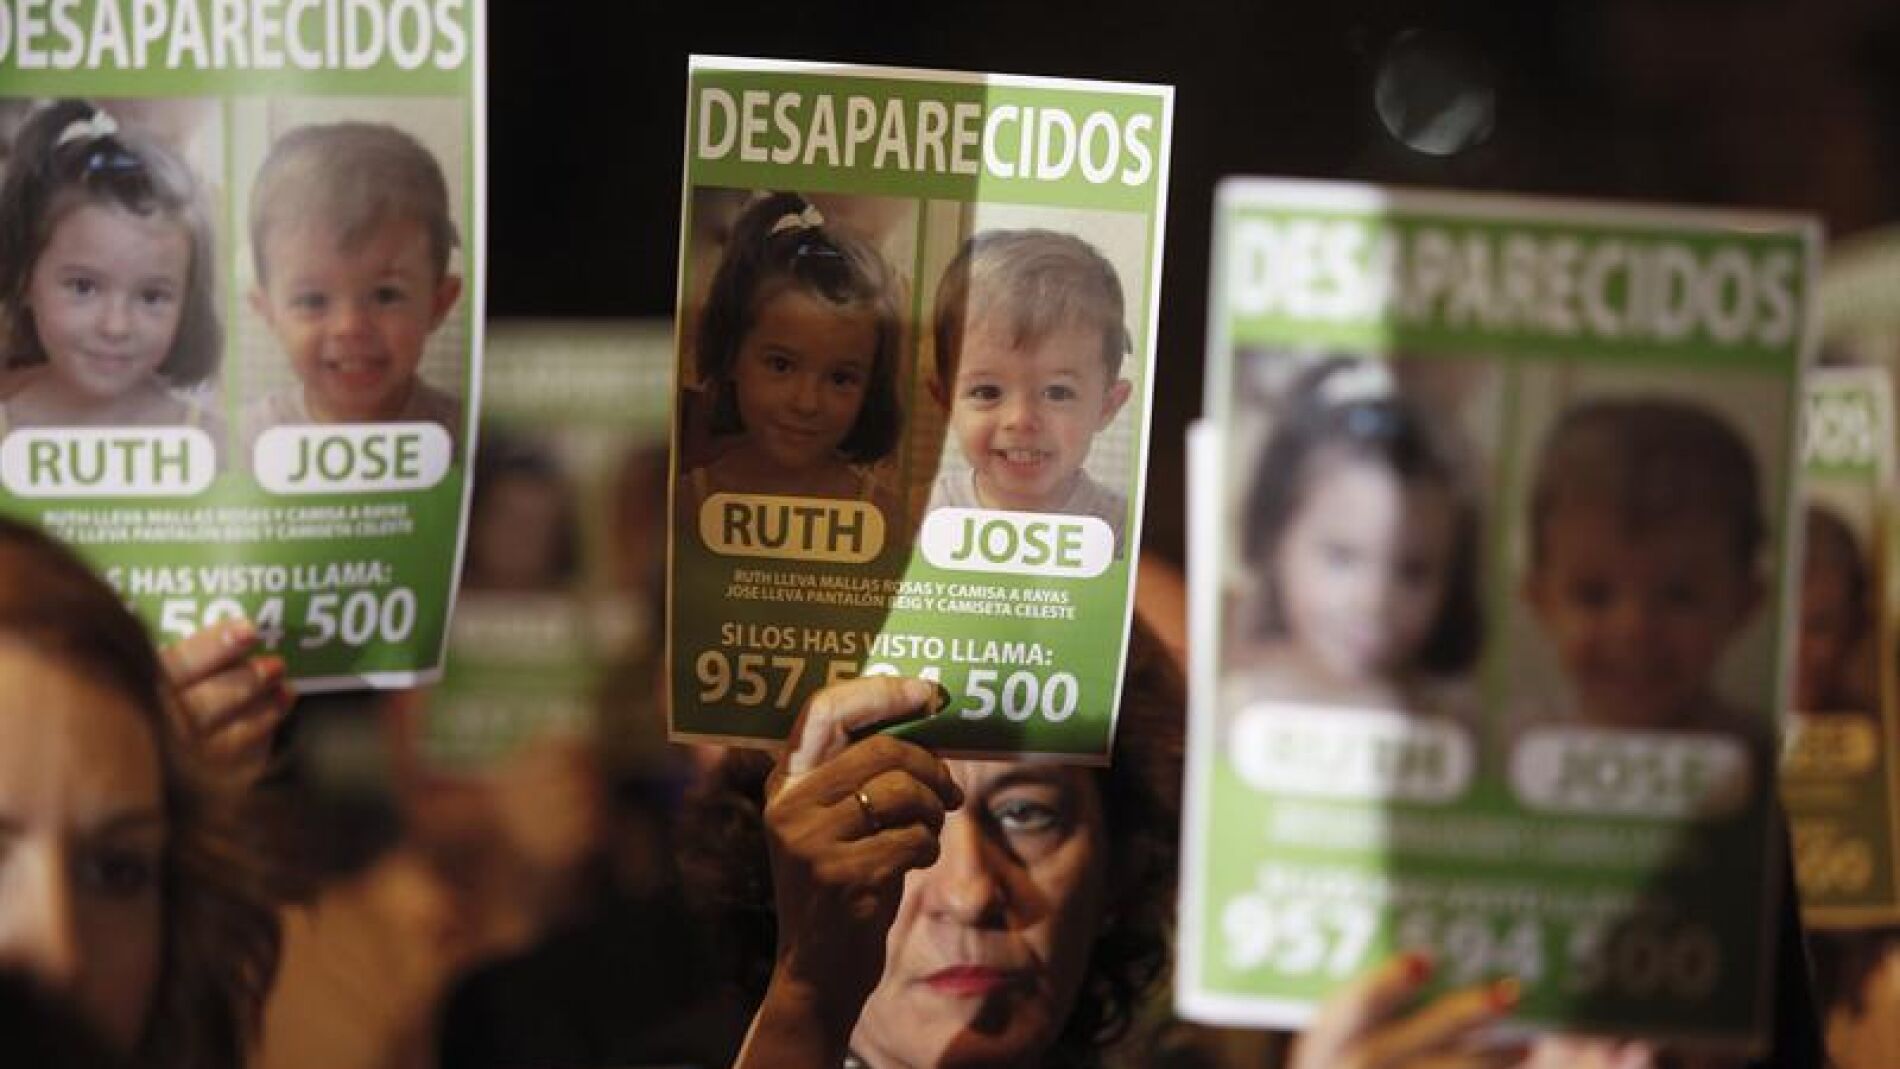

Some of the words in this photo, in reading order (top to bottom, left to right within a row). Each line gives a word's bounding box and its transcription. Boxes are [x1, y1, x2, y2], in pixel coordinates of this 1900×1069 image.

[698, 87, 1153, 186] DESAPARECIDOS
[1233, 214, 1797, 347] DESAPARECIDOS
[28, 438, 190, 485] RUTH
[287, 434, 420, 482] JOSE
[723, 503, 864, 553] RUTH
[950, 517, 1084, 568] JOSE
[131, 565, 194, 594] HAS
[199, 565, 289, 594] VISTO
[293, 560, 393, 591] LLAMA:
[724, 584, 760, 600] JOSE
[762, 586, 803, 602] LLEVA
[924, 597, 934, 610] Y
[937, 598, 1012, 615] CAMISETA
[1015, 602, 1076, 620] CELESTE
[734, 569, 772, 584] RUTH
[774, 572, 816, 588] LLEVA
[820, 575, 880, 592] MALLAS
[935, 582, 946, 596] Y
[949, 583, 1006, 600] CAMISA
[1007, 587, 1020, 602] A
[1023, 588, 1069, 604] RAYAS
[301, 587, 418, 646] 500
[721, 622, 742, 646] SI
[750, 624, 796, 649] LOS
[802, 629, 856, 654] HAS
[863, 631, 944, 659] VISTO
[952, 638, 1053, 665] LLAMA:
[696, 650, 806, 709] 957
[959, 669, 1079, 722] 500
[1220, 893, 1377, 981] 957
